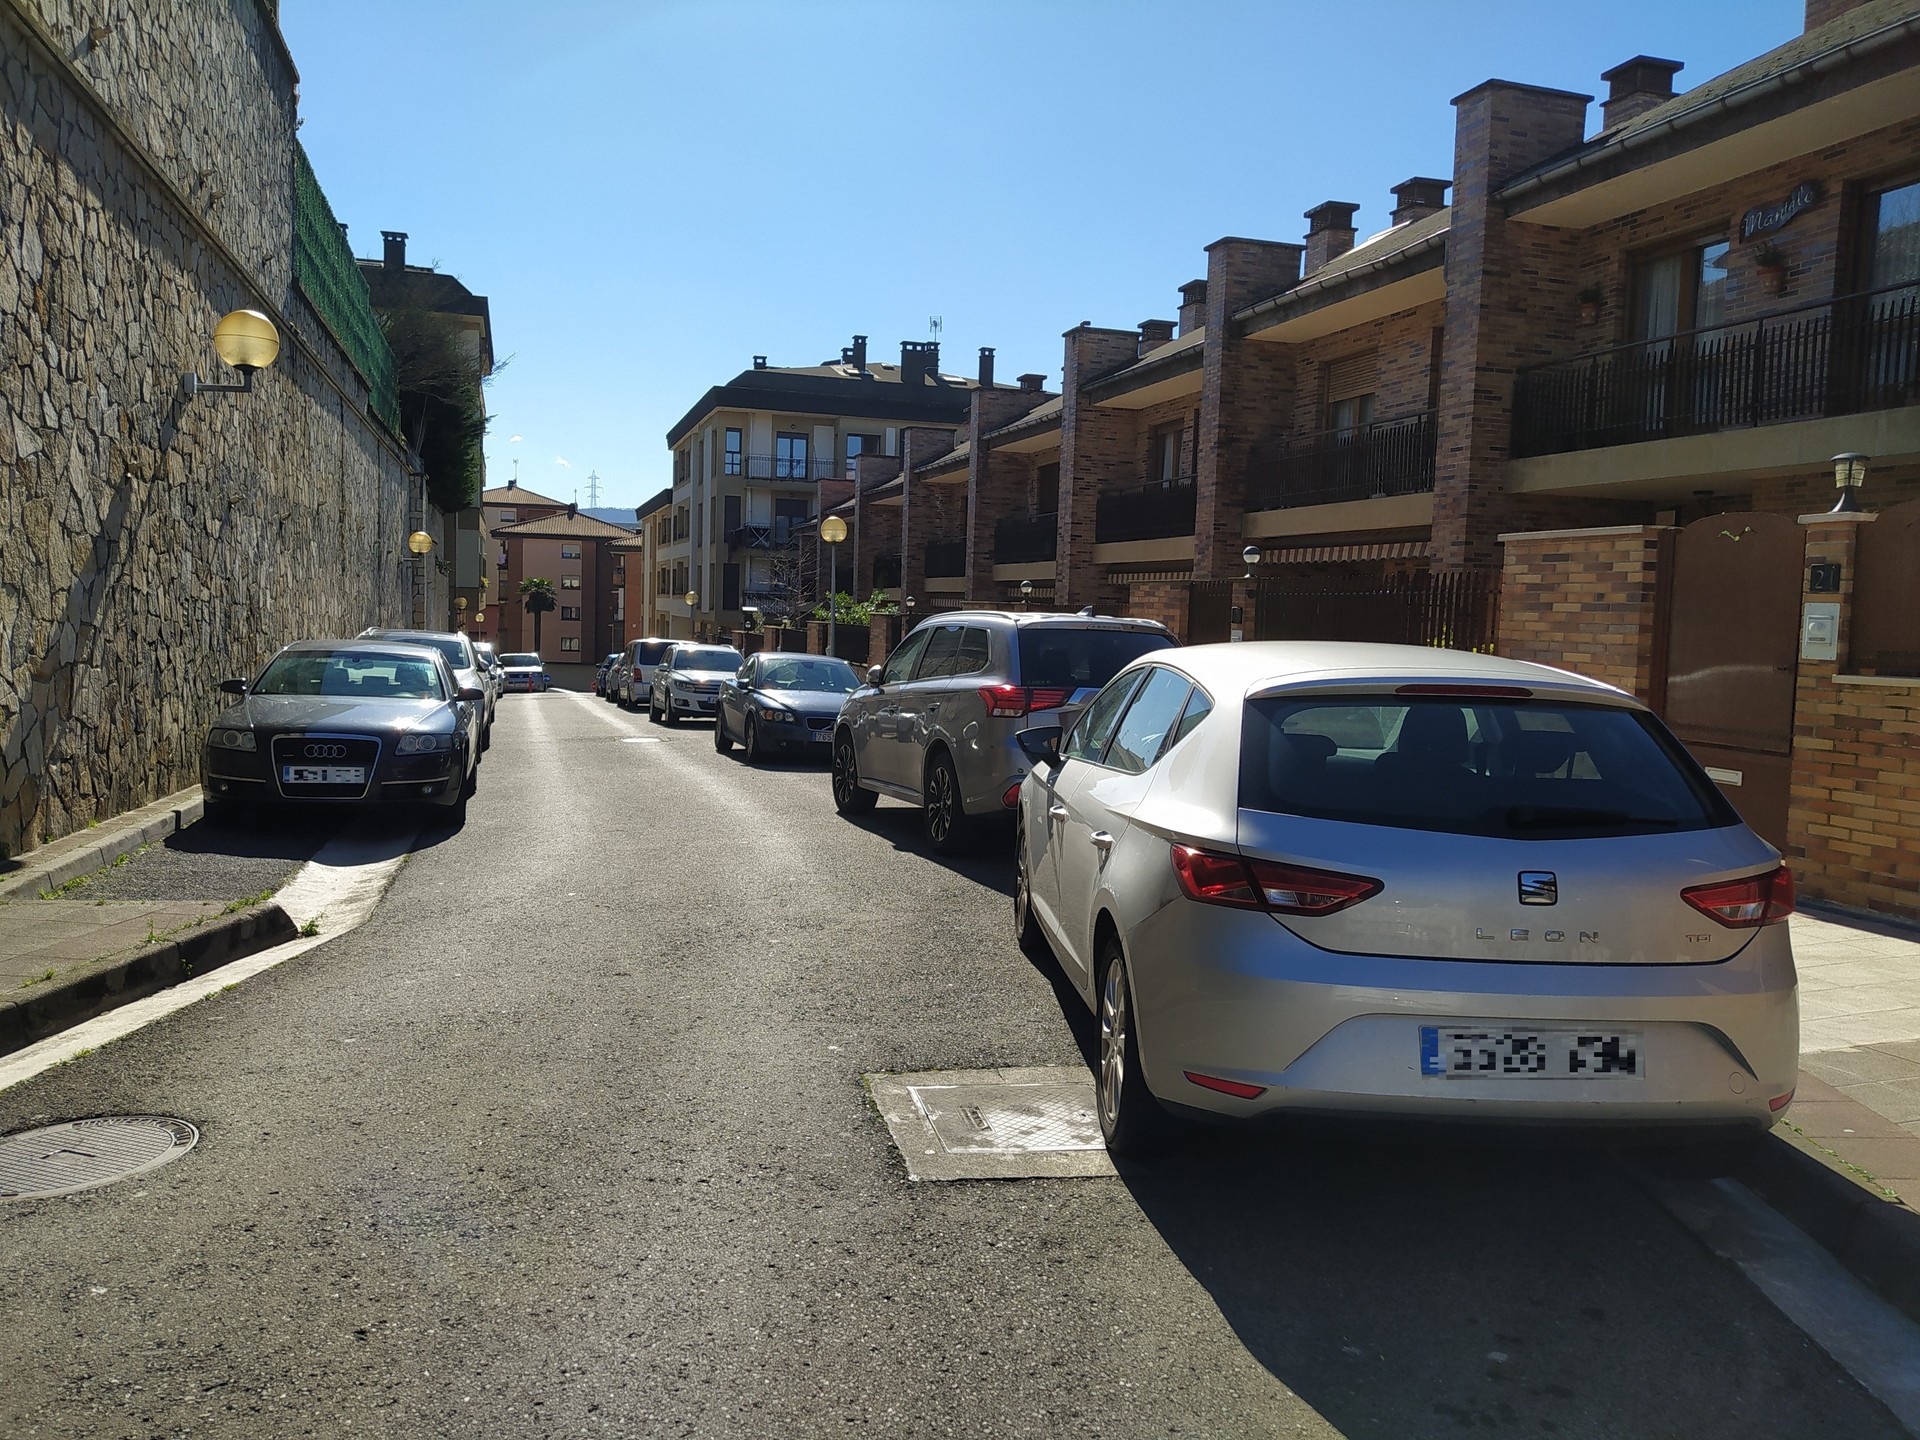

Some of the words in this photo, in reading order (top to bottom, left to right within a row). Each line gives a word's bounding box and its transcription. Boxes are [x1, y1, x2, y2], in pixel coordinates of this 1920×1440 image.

[1815, 570, 1834, 590] 21
[817, 733, 834, 741] 765
[1475, 927, 1600, 944] LEON
